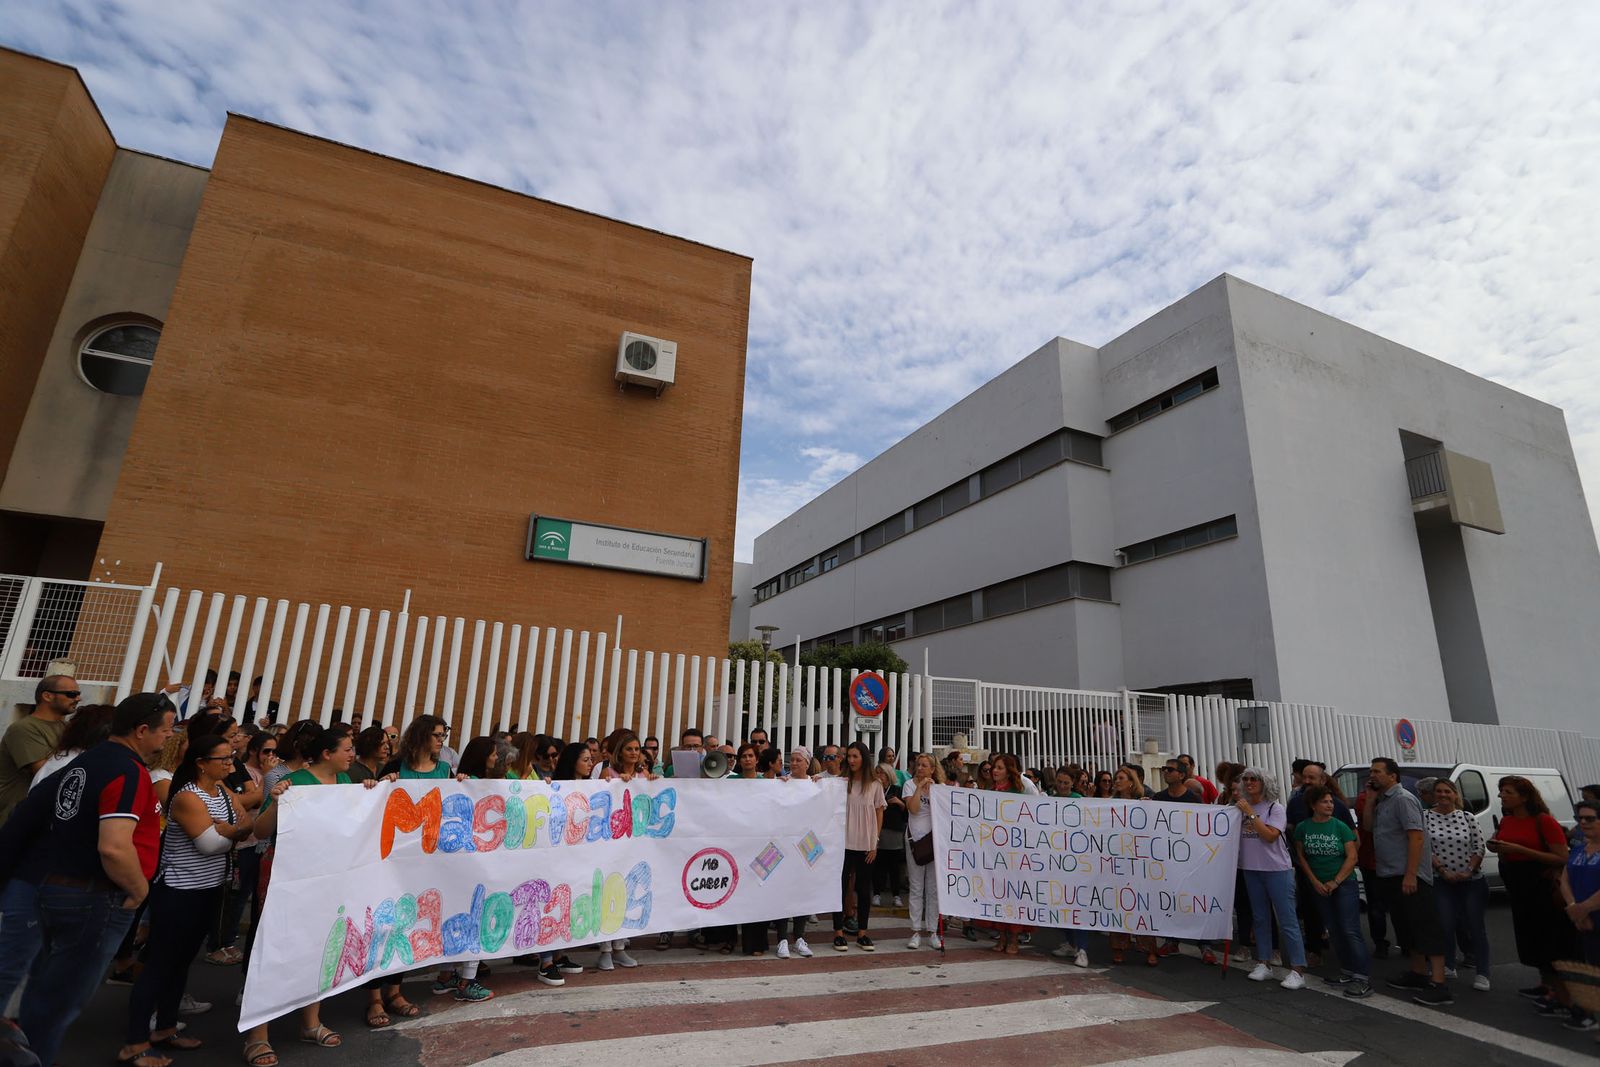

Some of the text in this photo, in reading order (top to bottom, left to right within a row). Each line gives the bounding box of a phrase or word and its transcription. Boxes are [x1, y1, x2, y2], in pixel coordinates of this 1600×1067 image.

[595, 538, 696, 559] Instituto de Educación Secundaria
[951, 790, 1230, 837] EDUCACIÓN NO ACTUÓ
[950, 820, 976, 843] LA
[1107, 832, 1191, 862] CRECIÓ
[1205, 842, 1220, 864] Y
[947, 849, 976, 871] EN
[983, 852, 1045, 872] LATAS
[1049, 853, 1092, 873] NOS
[947, 873, 984, 898] POR
[992, 877, 1033, 901] UNA
[1018, 906, 1081, 925] FUENTE
